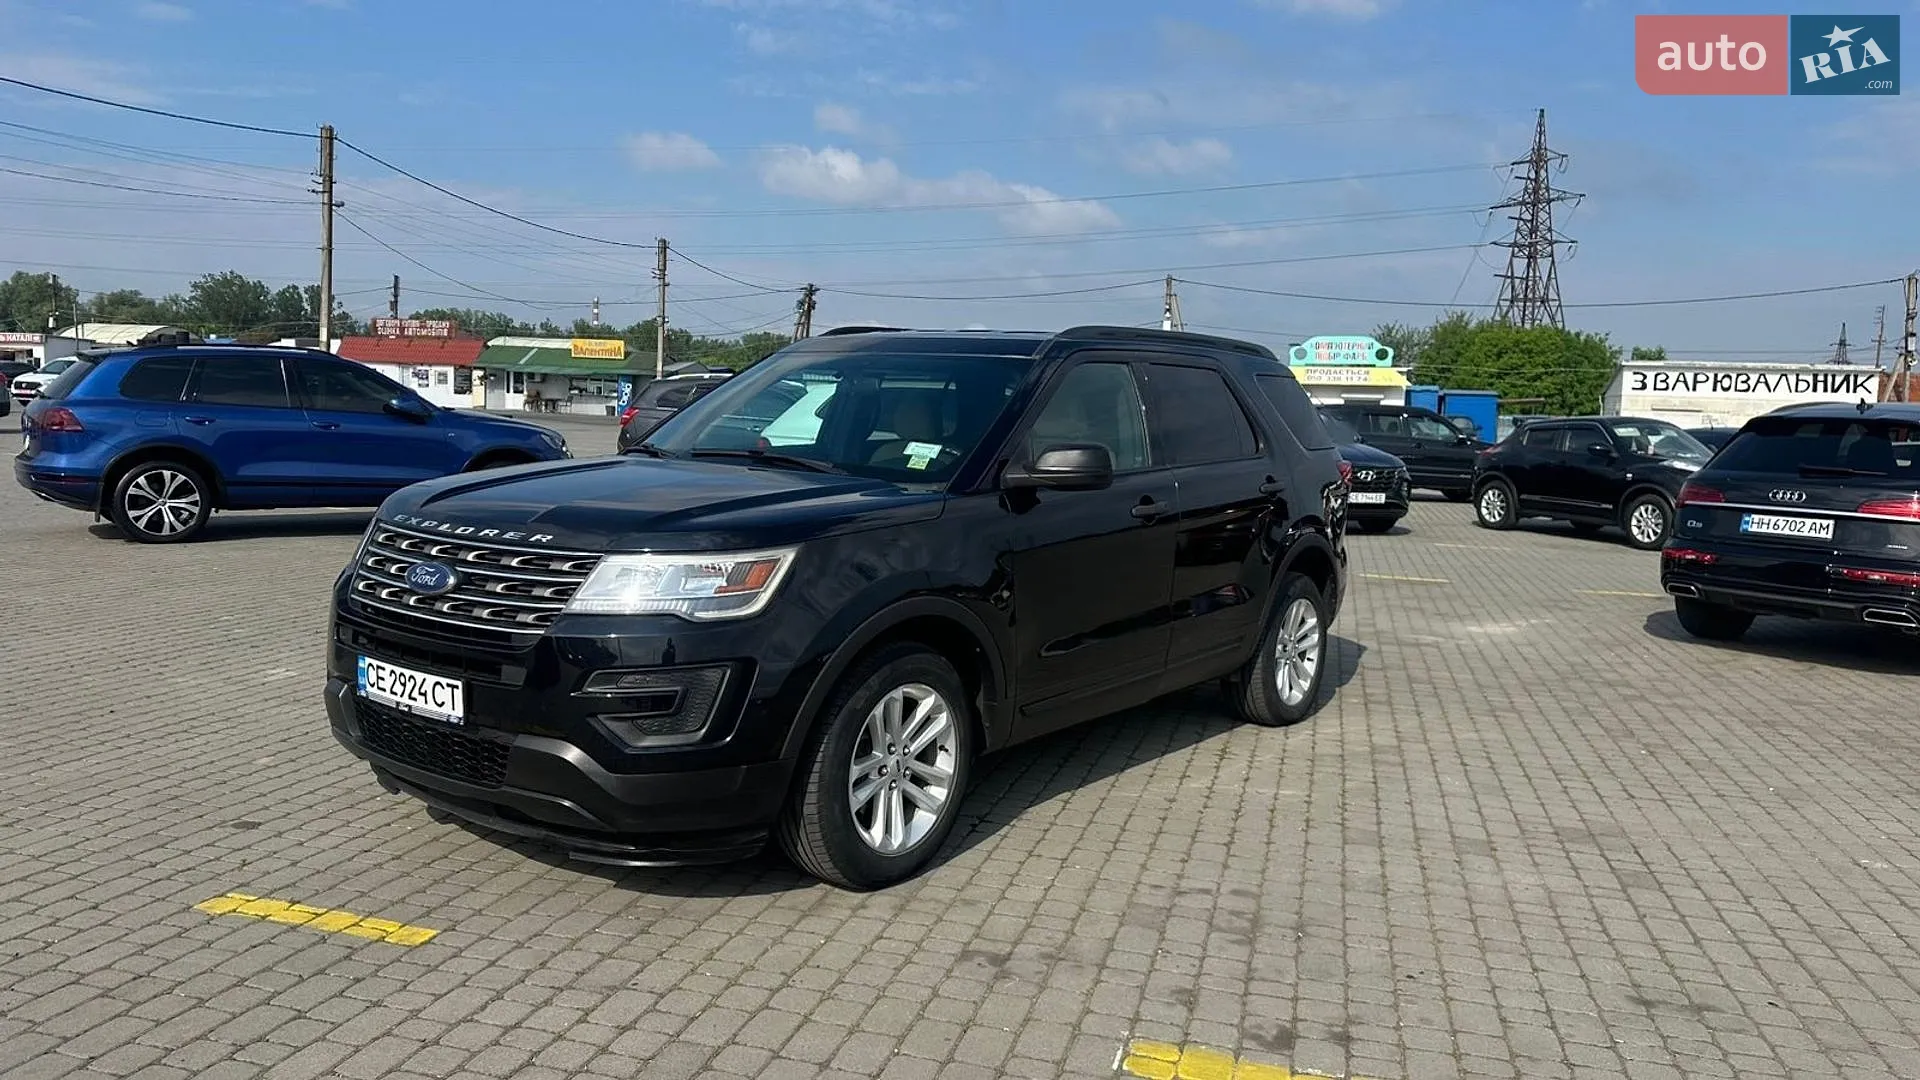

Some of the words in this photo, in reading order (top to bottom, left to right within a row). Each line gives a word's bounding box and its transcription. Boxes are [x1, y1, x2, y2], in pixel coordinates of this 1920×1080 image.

[1631, 371, 1875, 394] ЗВАРЮВАЛЬНИК
[392, 513, 555, 543] EXPLORER
[1751, 516, 1772, 531] HH
[1773, 517, 1806, 533] 6702
[1808, 521, 1830, 536] AM
[410, 565, 439, 587] Ford
[366, 662, 387, 693] CE
[389, 669, 428, 706] 2924
[431, 680, 460, 712] CT
